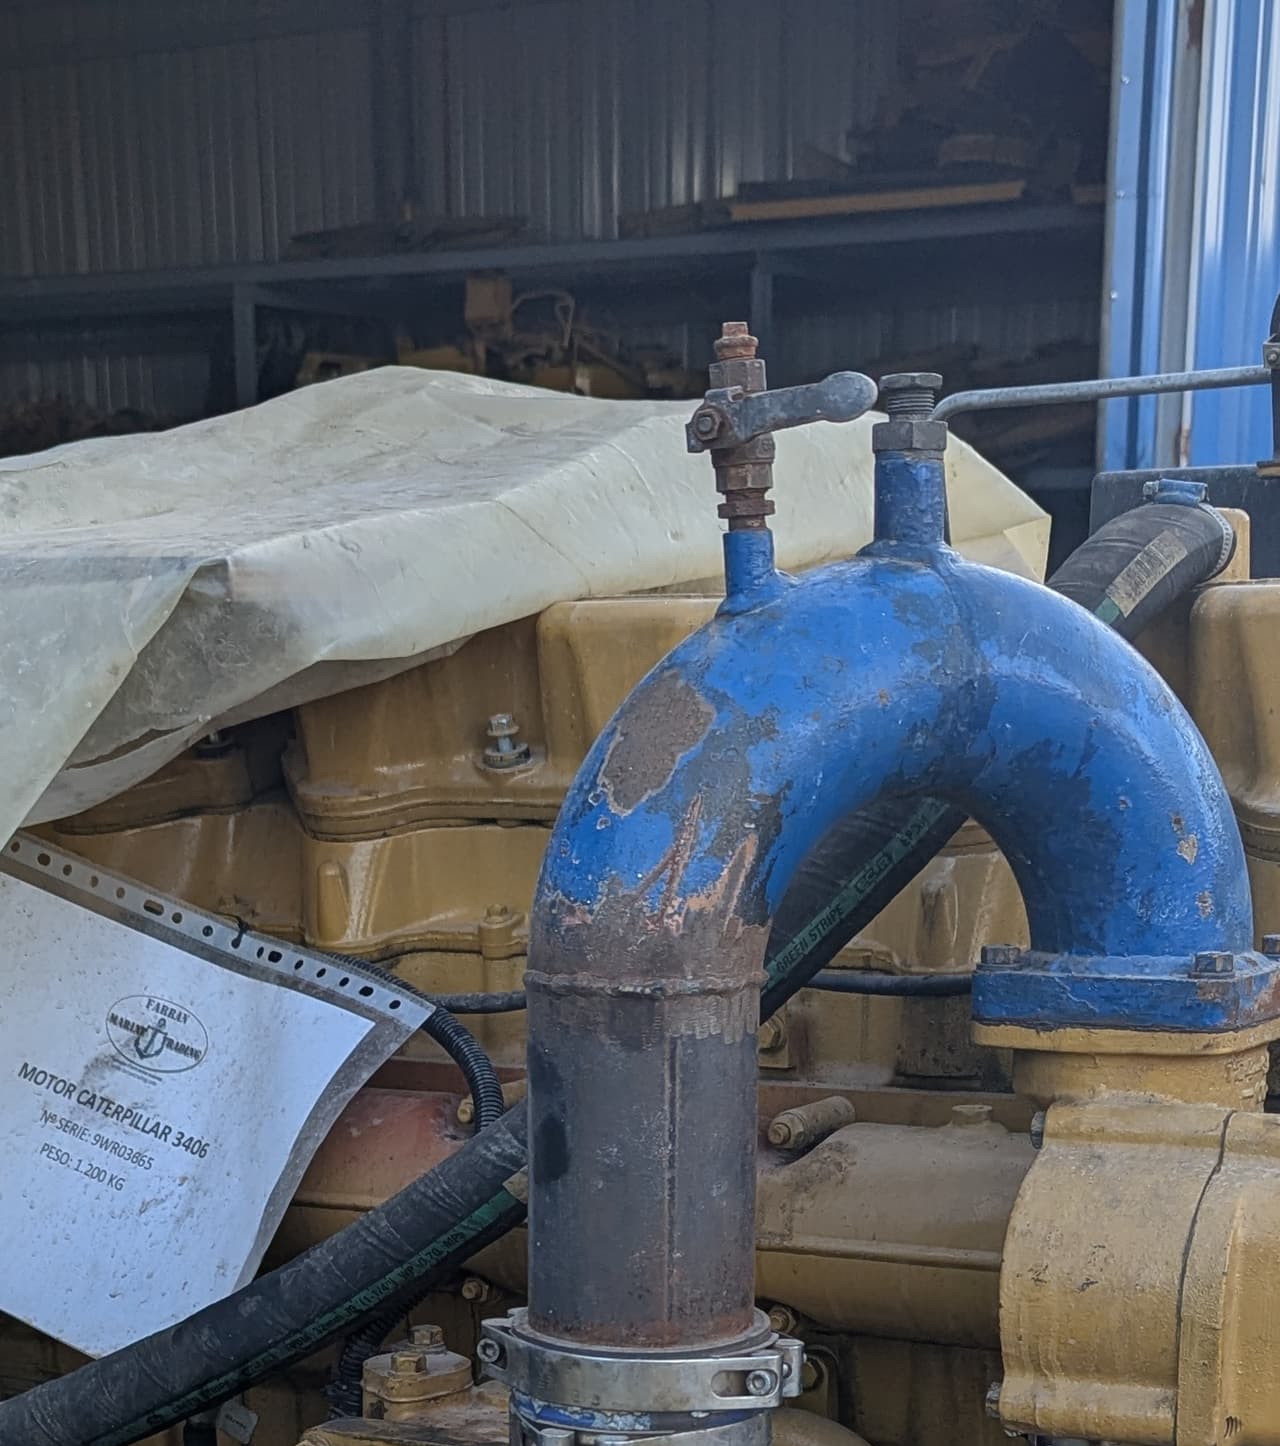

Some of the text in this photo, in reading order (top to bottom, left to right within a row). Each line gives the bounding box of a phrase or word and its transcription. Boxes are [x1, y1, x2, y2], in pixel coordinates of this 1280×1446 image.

[776, 937, 809, 973] GREEN
[809, 902, 844, 942] STRIPE
[17, 1062, 77, 1101] MOTOR
[76, 1088, 173, 1143] CATERPILLAR
[171, 1130, 211, 1160] 3406
[56, 1117, 93, 1143] SERIE:
[40, 1142, 126, 1192] PESO: 1.200 KG
